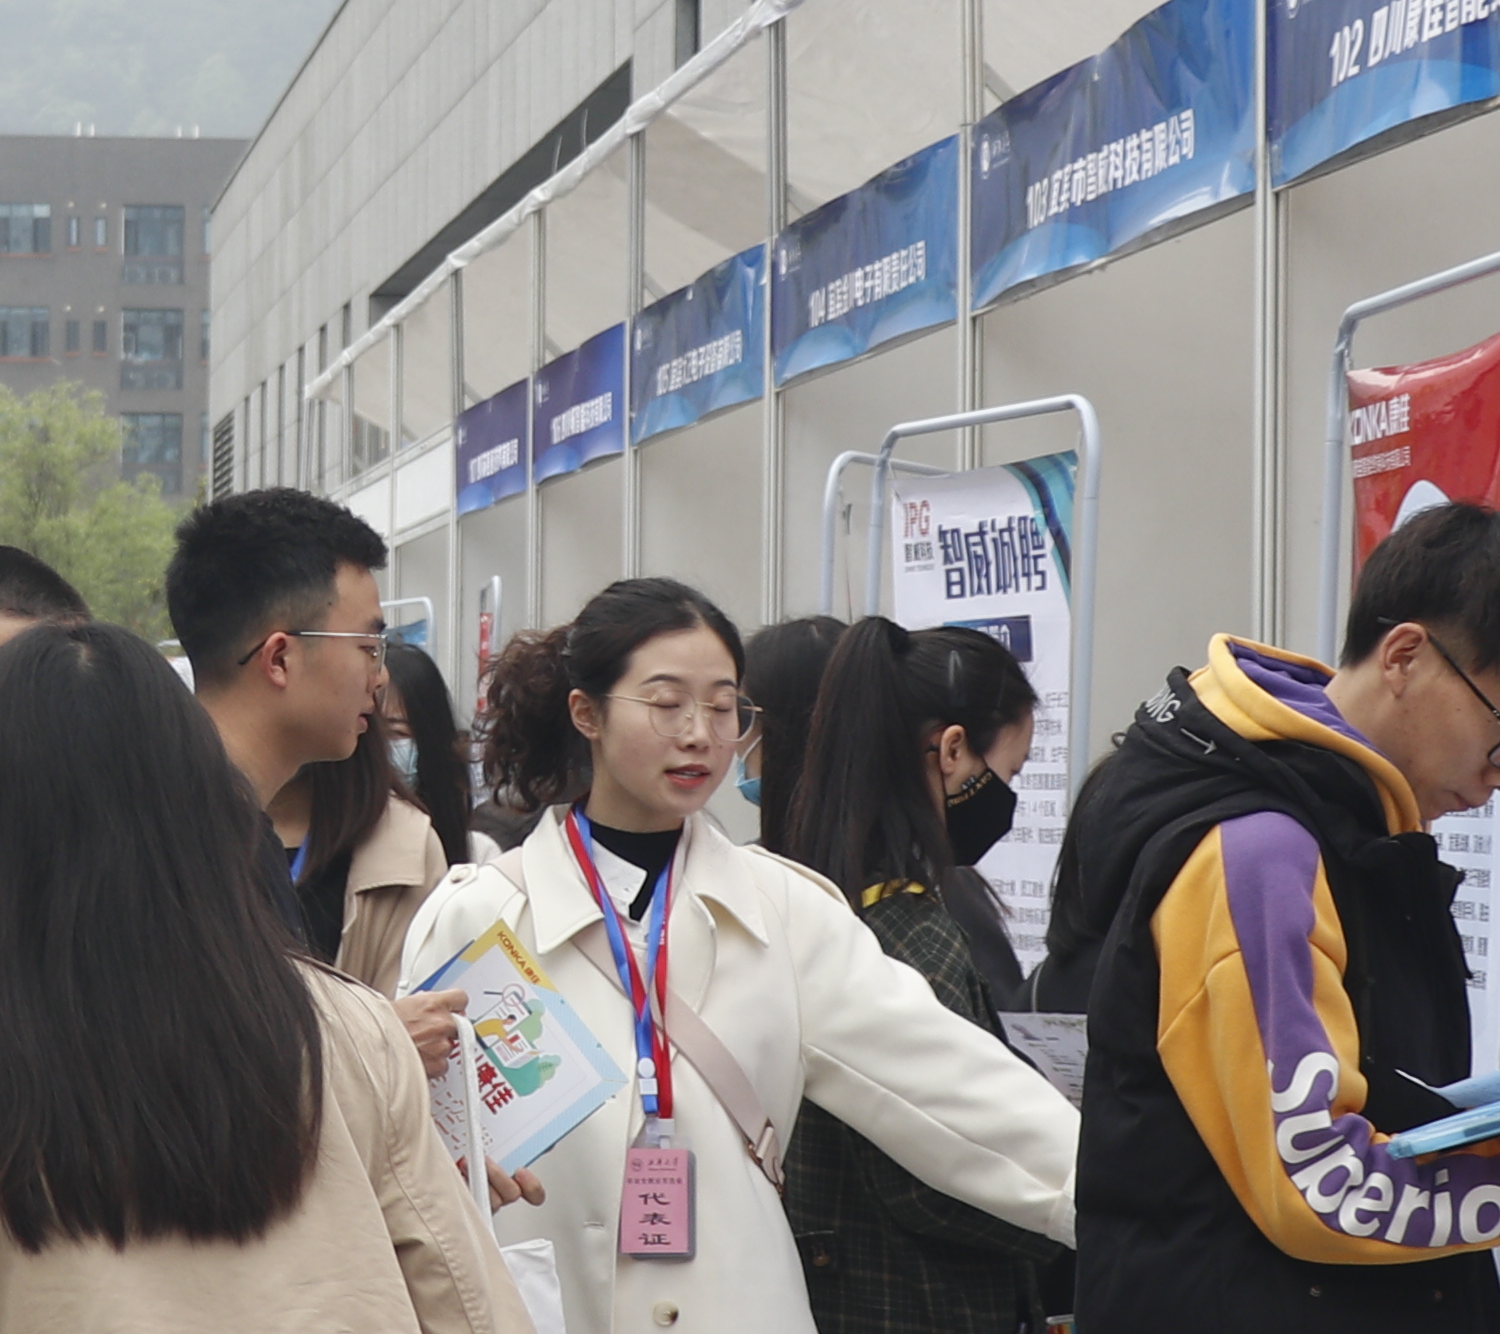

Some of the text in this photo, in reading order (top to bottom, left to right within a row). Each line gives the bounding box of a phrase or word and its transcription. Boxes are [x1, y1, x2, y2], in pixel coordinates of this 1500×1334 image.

[1327, 18, 1366, 88] 102
[1025, 176, 1050, 230] 103
[1048, 108, 1196, 218] 宜宾市智威科技有限公司
[807, 288, 827, 329] 104
[937, 515, 1049, 601] 智威诚聘
[497, 930, 528, 971] KONKA
[637, 1192, 672, 1246] 代表证
